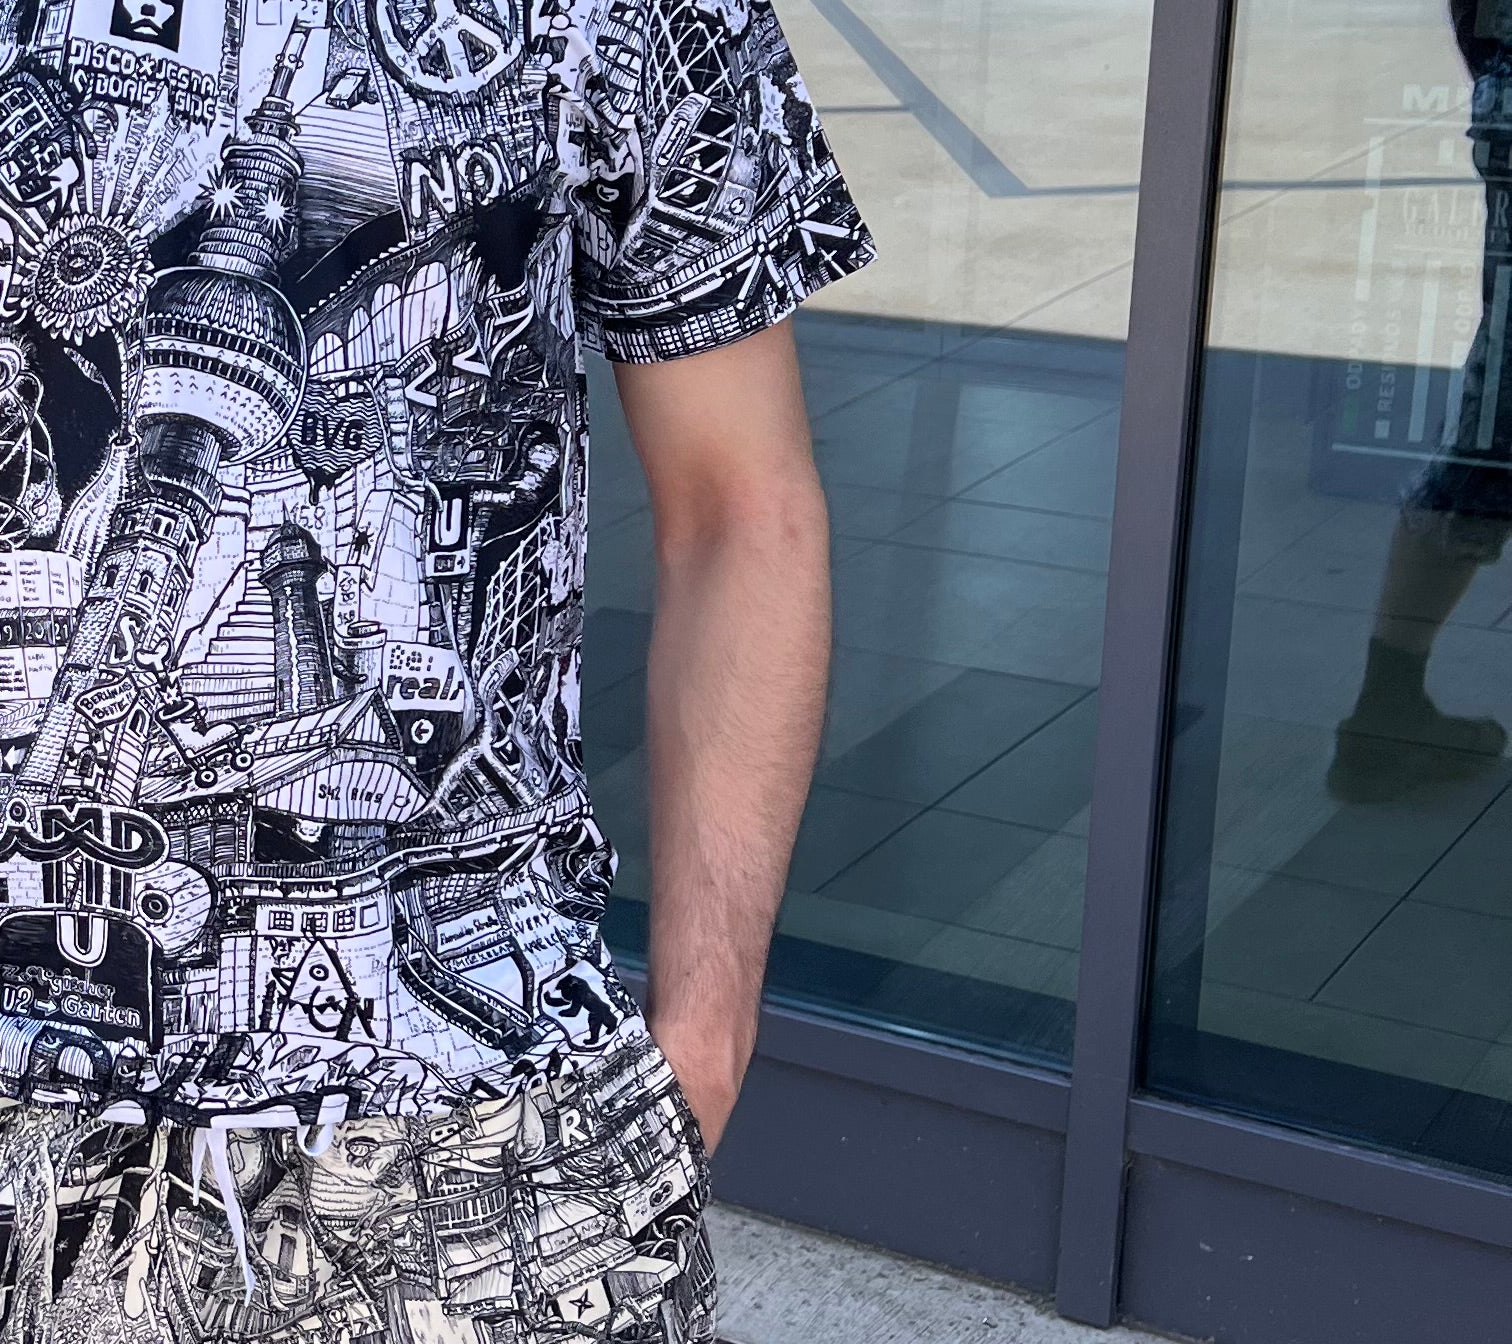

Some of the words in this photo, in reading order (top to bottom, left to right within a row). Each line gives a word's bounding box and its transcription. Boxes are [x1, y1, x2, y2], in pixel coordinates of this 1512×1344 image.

[515, 911, 551, 934] VERY
[2, 983, 35, 1015] U2
[61, 994, 144, 1029] Garten
